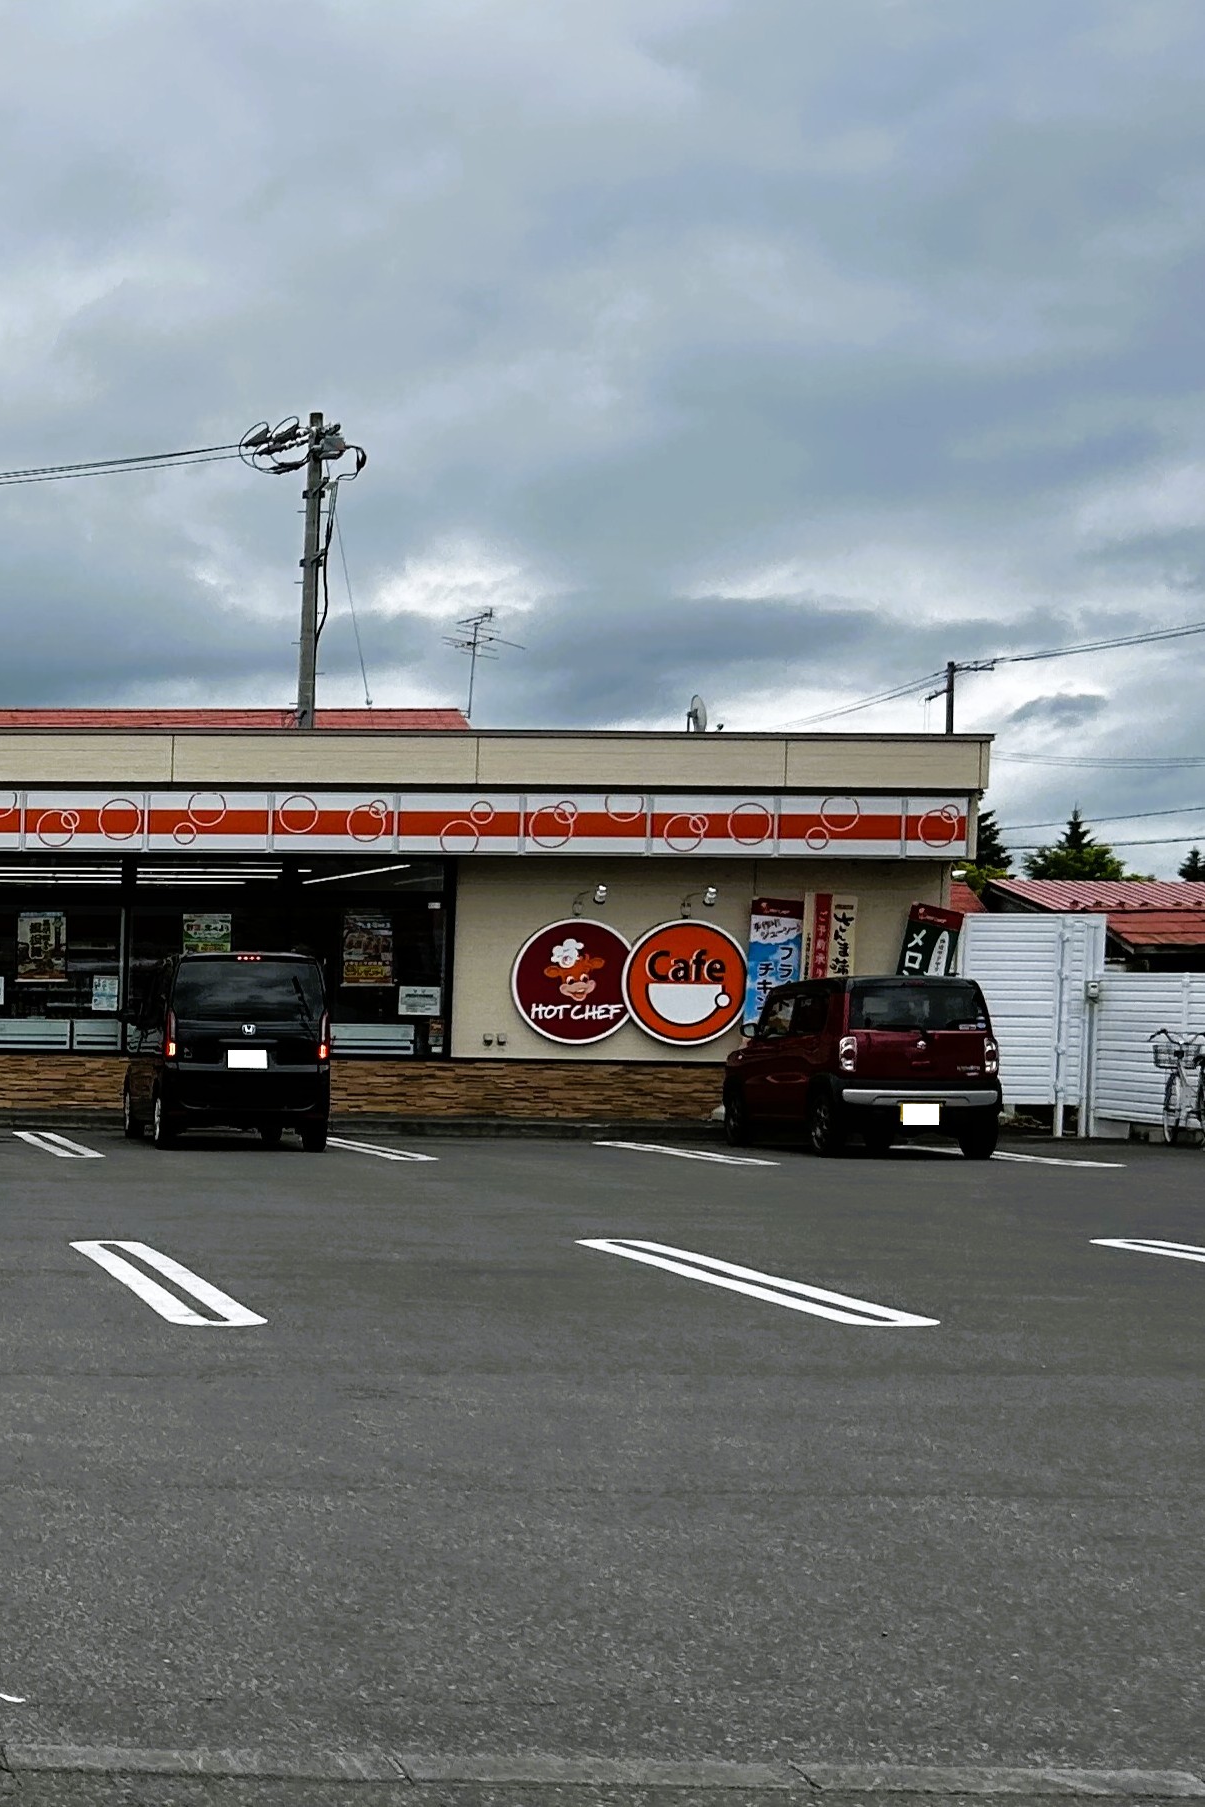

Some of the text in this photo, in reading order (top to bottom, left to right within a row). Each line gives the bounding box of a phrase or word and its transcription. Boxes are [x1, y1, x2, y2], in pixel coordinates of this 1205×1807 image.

[645, 949, 726, 983] Cafe
[530, 1003, 624, 1020] HOT CHEF
